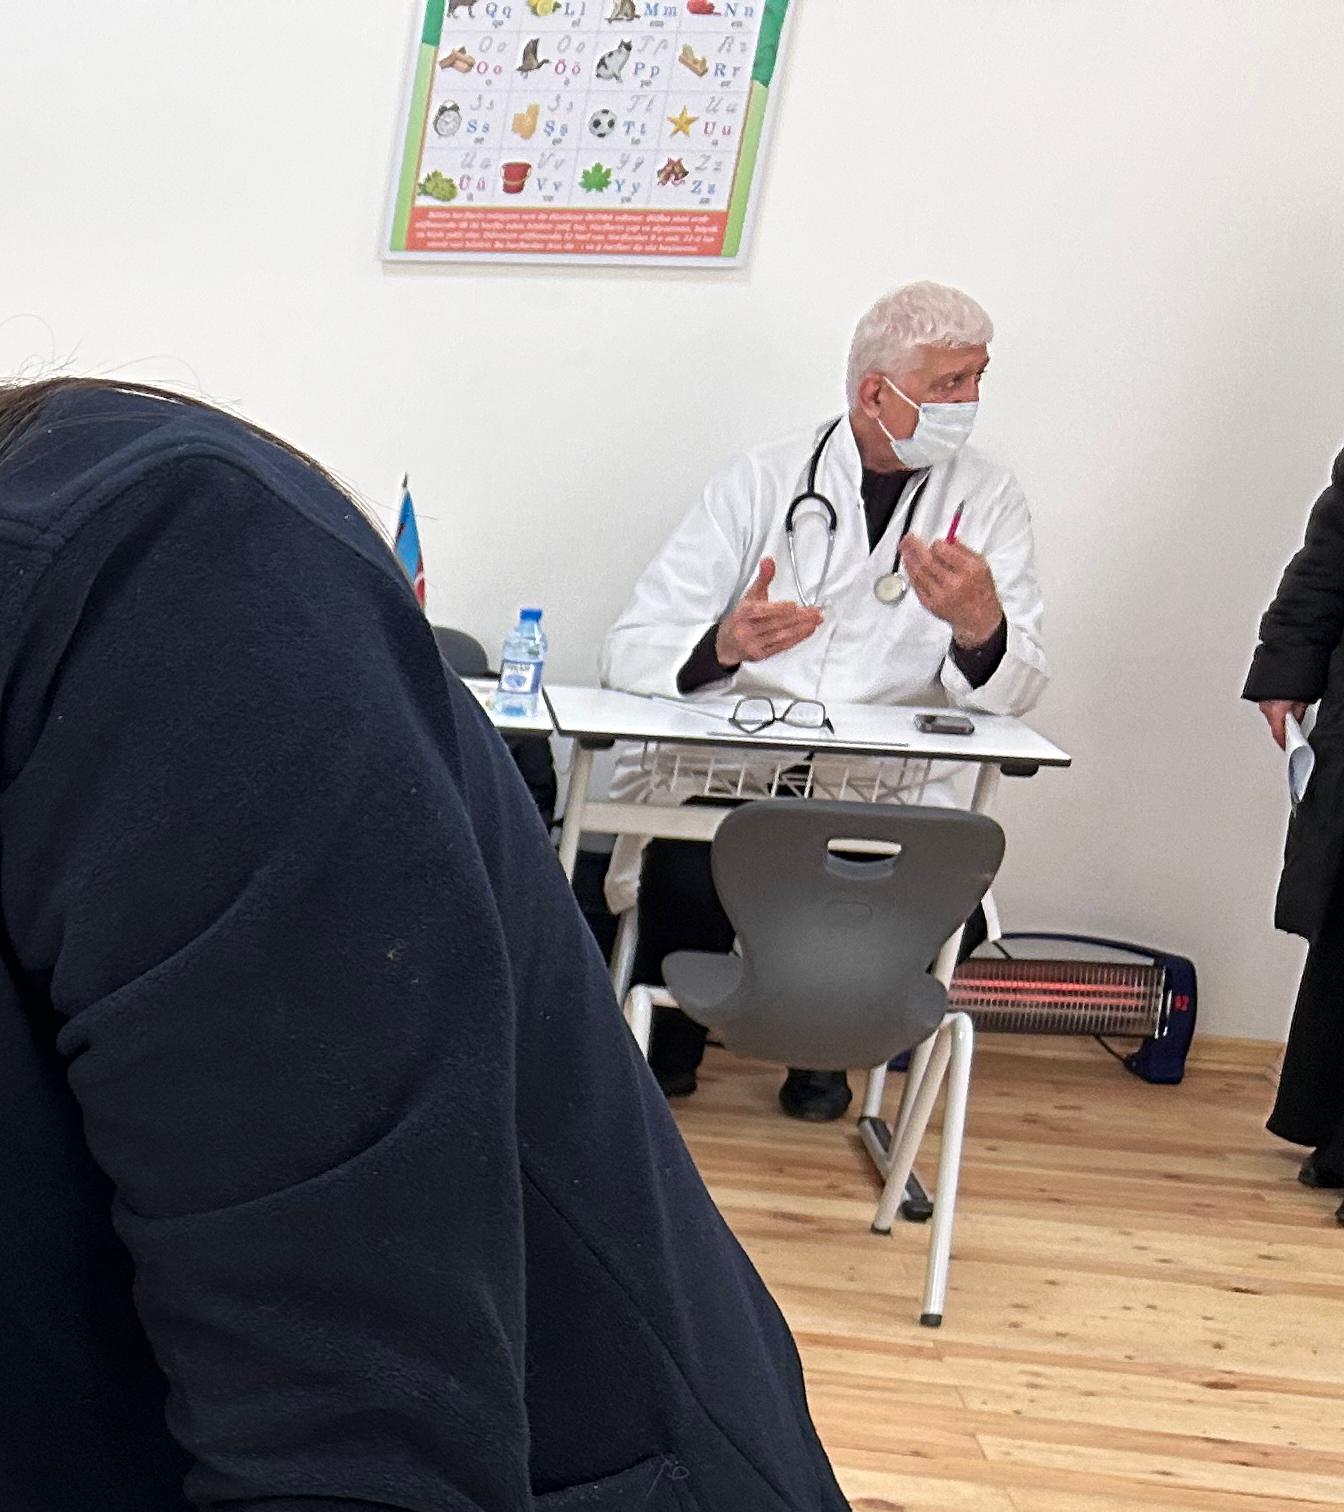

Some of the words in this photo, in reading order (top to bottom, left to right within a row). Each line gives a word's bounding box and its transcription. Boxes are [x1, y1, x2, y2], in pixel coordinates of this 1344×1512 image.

[486, 2, 497, 18] Q
[565, 2, 575, 16] L
[644, 3, 658, 16] M
[664, 6, 677, 16] m
[724, 3, 735, 16] N
[744, 6, 754, 17] n
[477, 61, 488, 74] O
[493, 65, 502, 74] o
[632, 63, 645, 75] P
[650, 66, 660, 78] p
[714, 63, 726, 77] R
[733, 66, 741, 76] r
[466, 120, 478, 133] S
[482, 122, 490, 133] s
[624, 121, 635, 135] T
[640, 123, 646, 134] t
[704, 122, 716, 135] U
[722, 126, 731, 135] u
[537, 178, 548, 191] V
[553, 182, 563, 191] v
[615, 179, 625, 192] Y
[632, 183, 640, 195] y
[690, 180, 702, 194] Z
